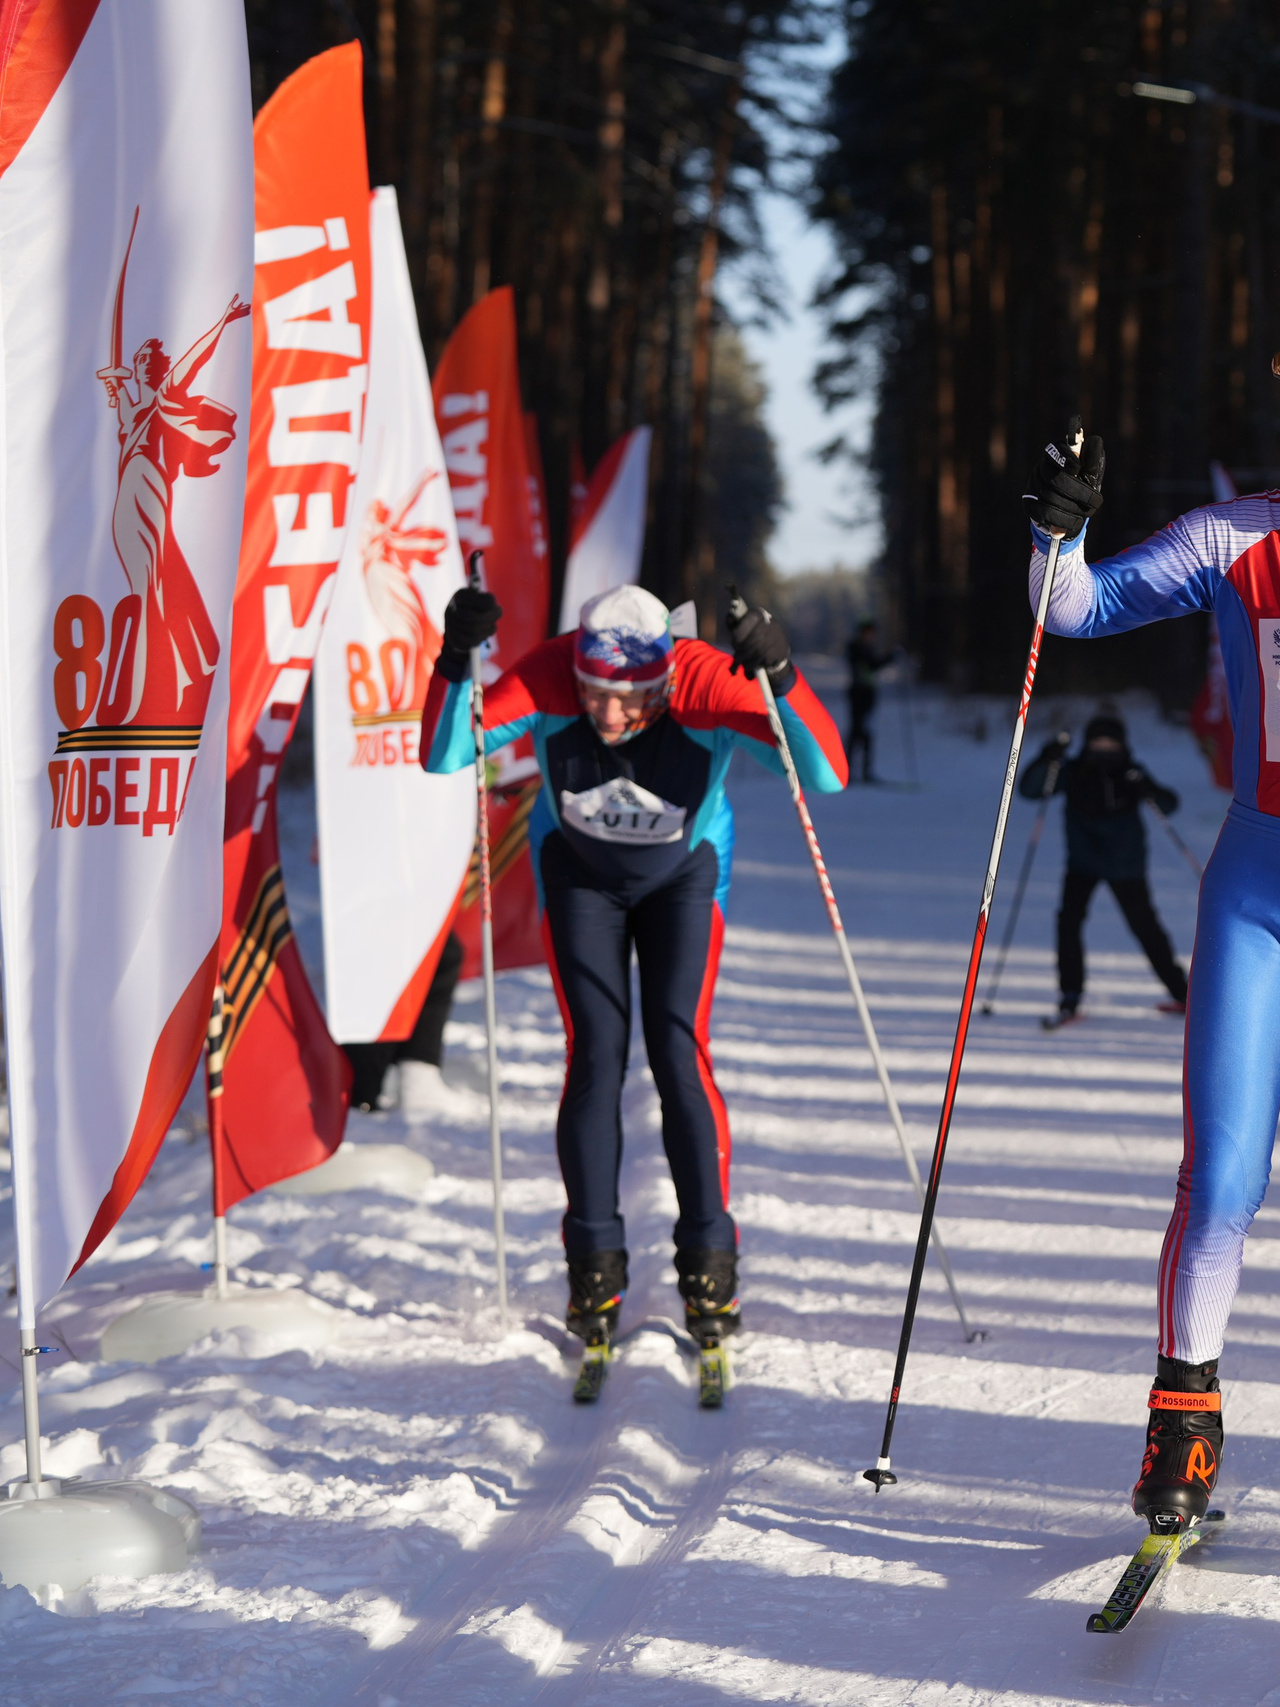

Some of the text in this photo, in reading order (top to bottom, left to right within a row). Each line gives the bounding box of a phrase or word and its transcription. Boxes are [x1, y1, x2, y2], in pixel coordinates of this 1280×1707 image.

[53, 594, 143, 731] 80
[346, 636, 412, 716] 80
[352, 729, 421, 767] ПОБЕ
[584, 811, 664, 830] 017
[1162, 1396, 1210, 1407] ROSSIGNOL
